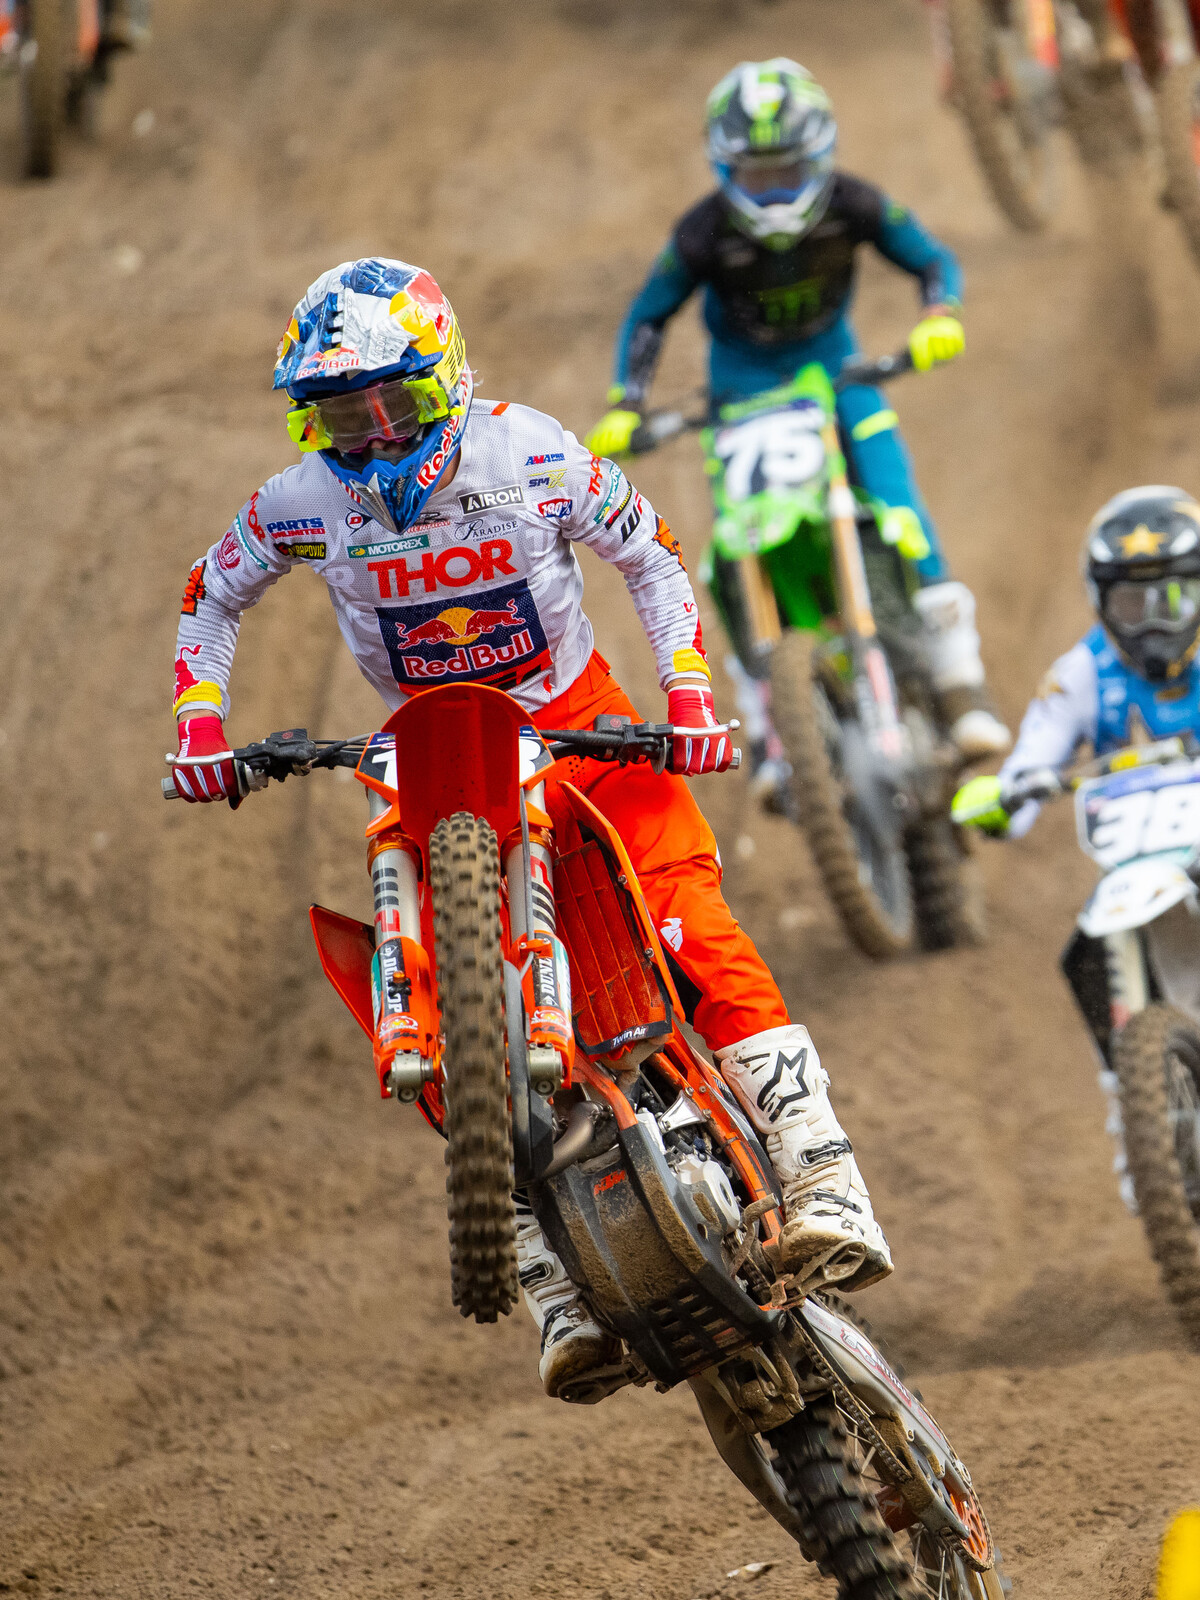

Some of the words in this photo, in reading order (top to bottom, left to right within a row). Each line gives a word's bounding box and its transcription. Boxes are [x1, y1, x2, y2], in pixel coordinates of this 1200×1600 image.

[328, 357, 360, 369] Bull
[416, 427, 455, 490] Red
[524, 454, 551, 466] AMA
[714, 406, 826, 501] 75
[528, 471, 566, 488] SMX
[467, 488, 522, 511] AIROH
[541, 500, 571, 517] 100%
[266, 517, 324, 534] PARTS
[367, 537, 424, 556] MOTOREX
[367, 538, 518, 599] THOR
[402, 647, 470, 678] Red
[469, 628, 535, 671] Bull
[611, 1030, 633, 1046] Twin
[633, 1025, 648, 1038] Air
[593, 1169, 627, 1197] KTM
